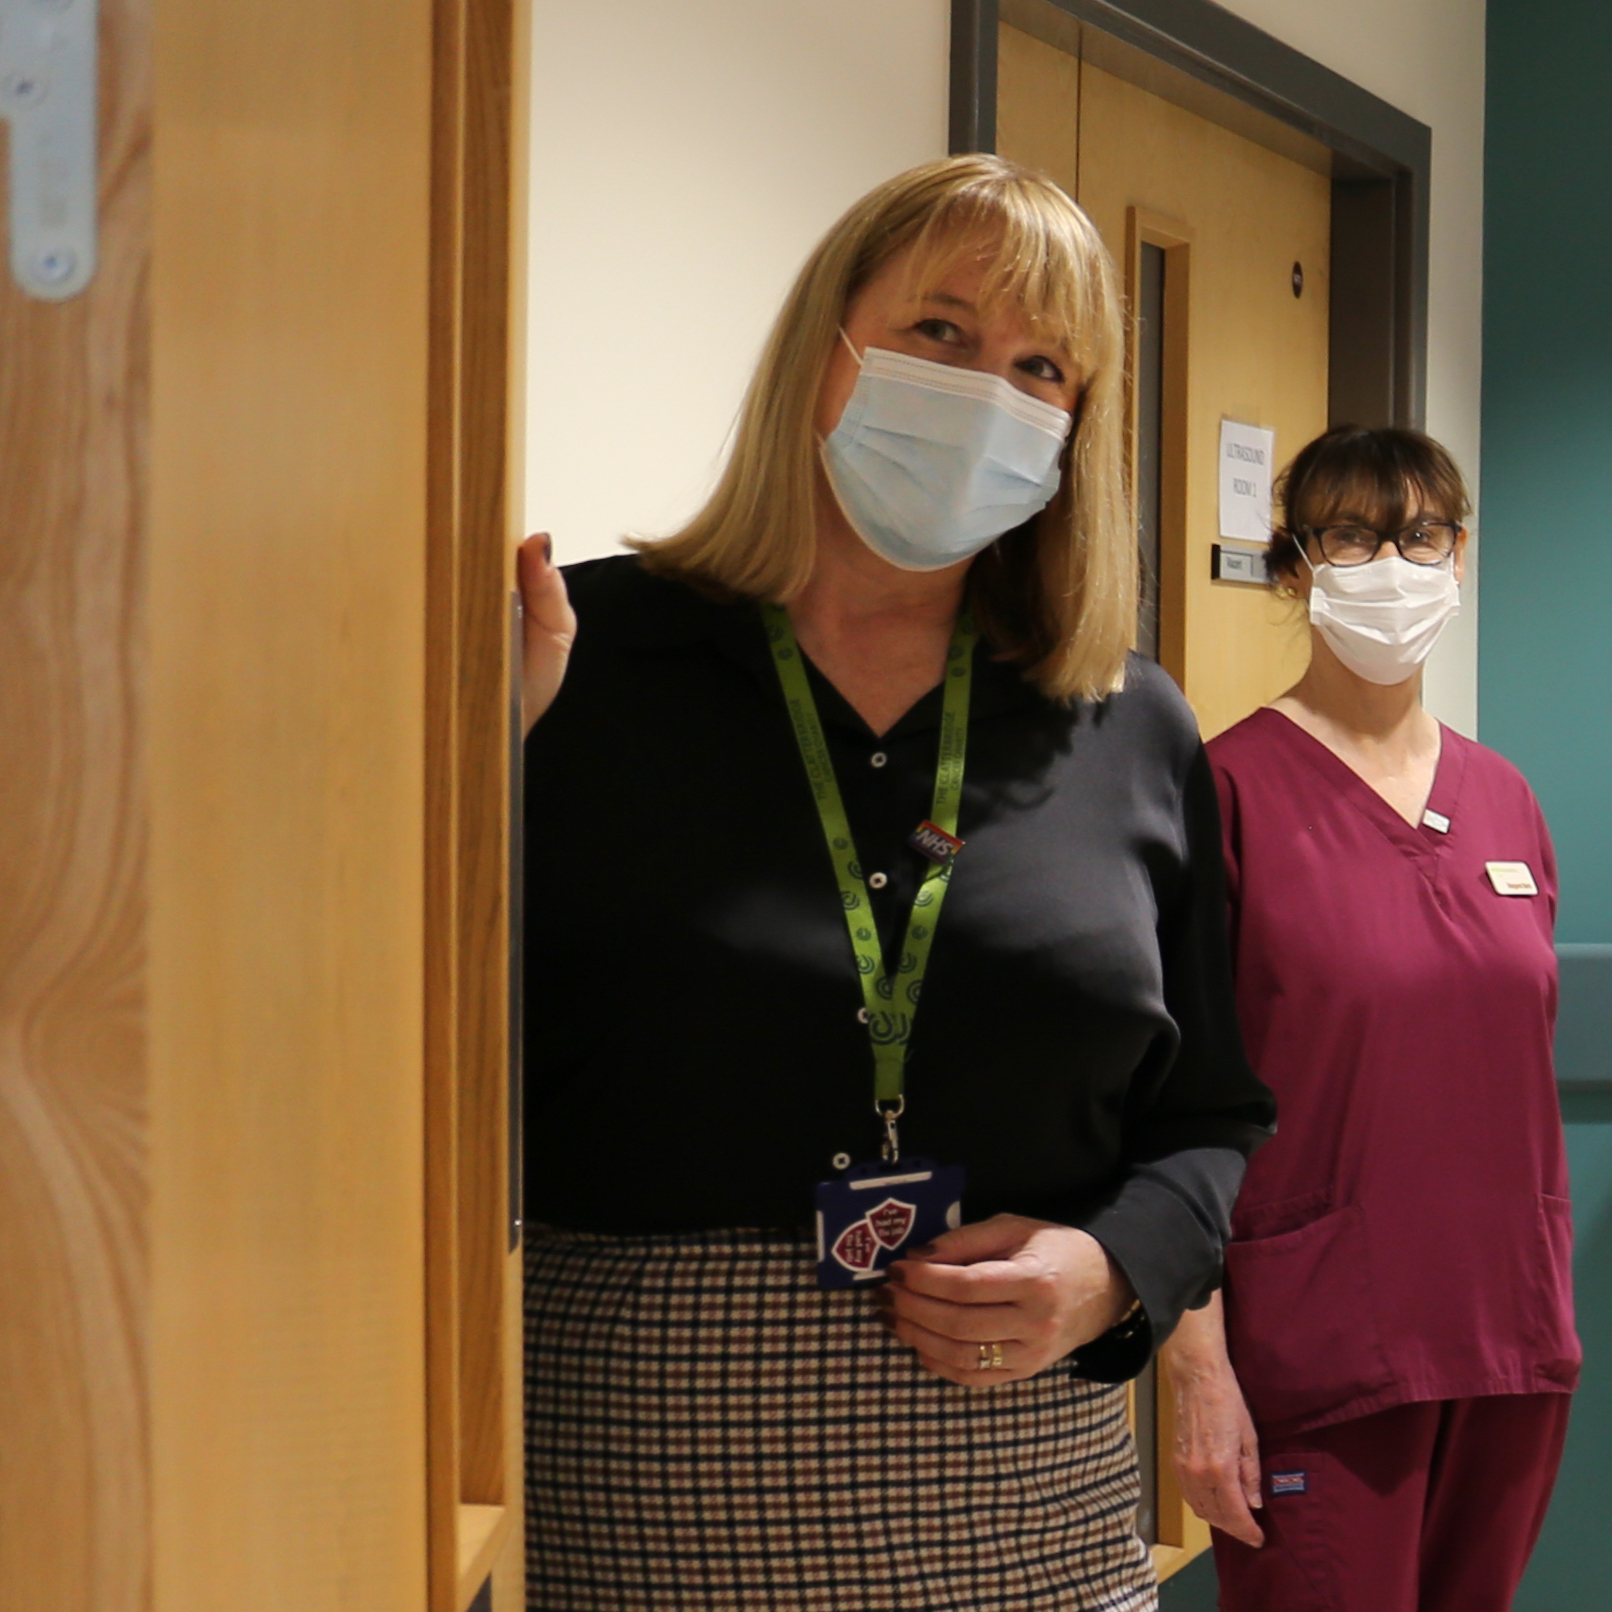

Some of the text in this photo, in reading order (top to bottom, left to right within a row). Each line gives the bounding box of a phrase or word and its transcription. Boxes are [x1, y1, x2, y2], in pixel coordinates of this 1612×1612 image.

[1226, 443, 1265, 466] ULTRASOUND
[1233, 477, 1252, 496] ROOM
[916, 830, 953, 855] NHS
